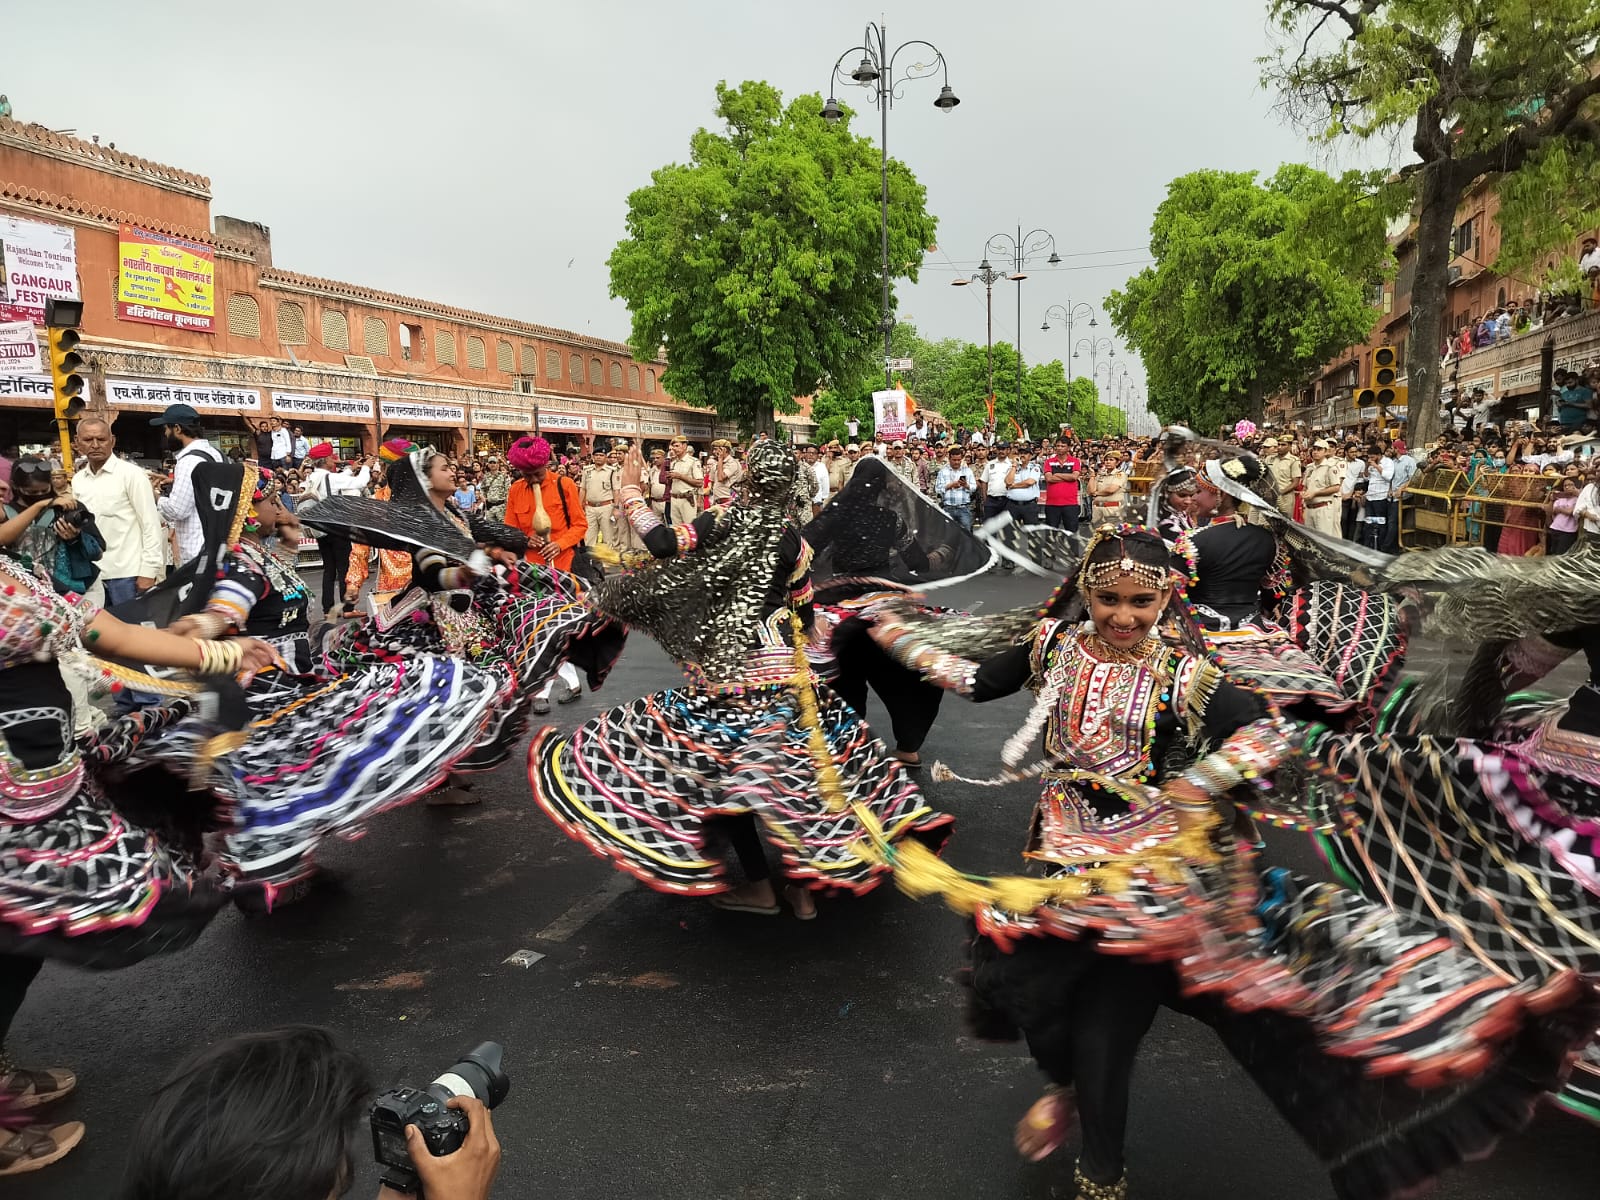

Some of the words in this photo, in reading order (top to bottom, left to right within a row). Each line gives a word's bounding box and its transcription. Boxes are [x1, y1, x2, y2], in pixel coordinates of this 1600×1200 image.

[6, 243, 42, 258] Rajasthan
[43, 250, 73, 263] Tourism
[17, 256, 44, 268] Welcomes
[123, 257, 152, 273] भारतीय
[11, 272, 73, 293] GANGAUR
[126, 304, 173, 323] हरिमोहन
[174, 311, 210, 328] कूलवाल
[172, 388, 191, 402] वॉच
[211, 390, 236, 405] रेडियो
